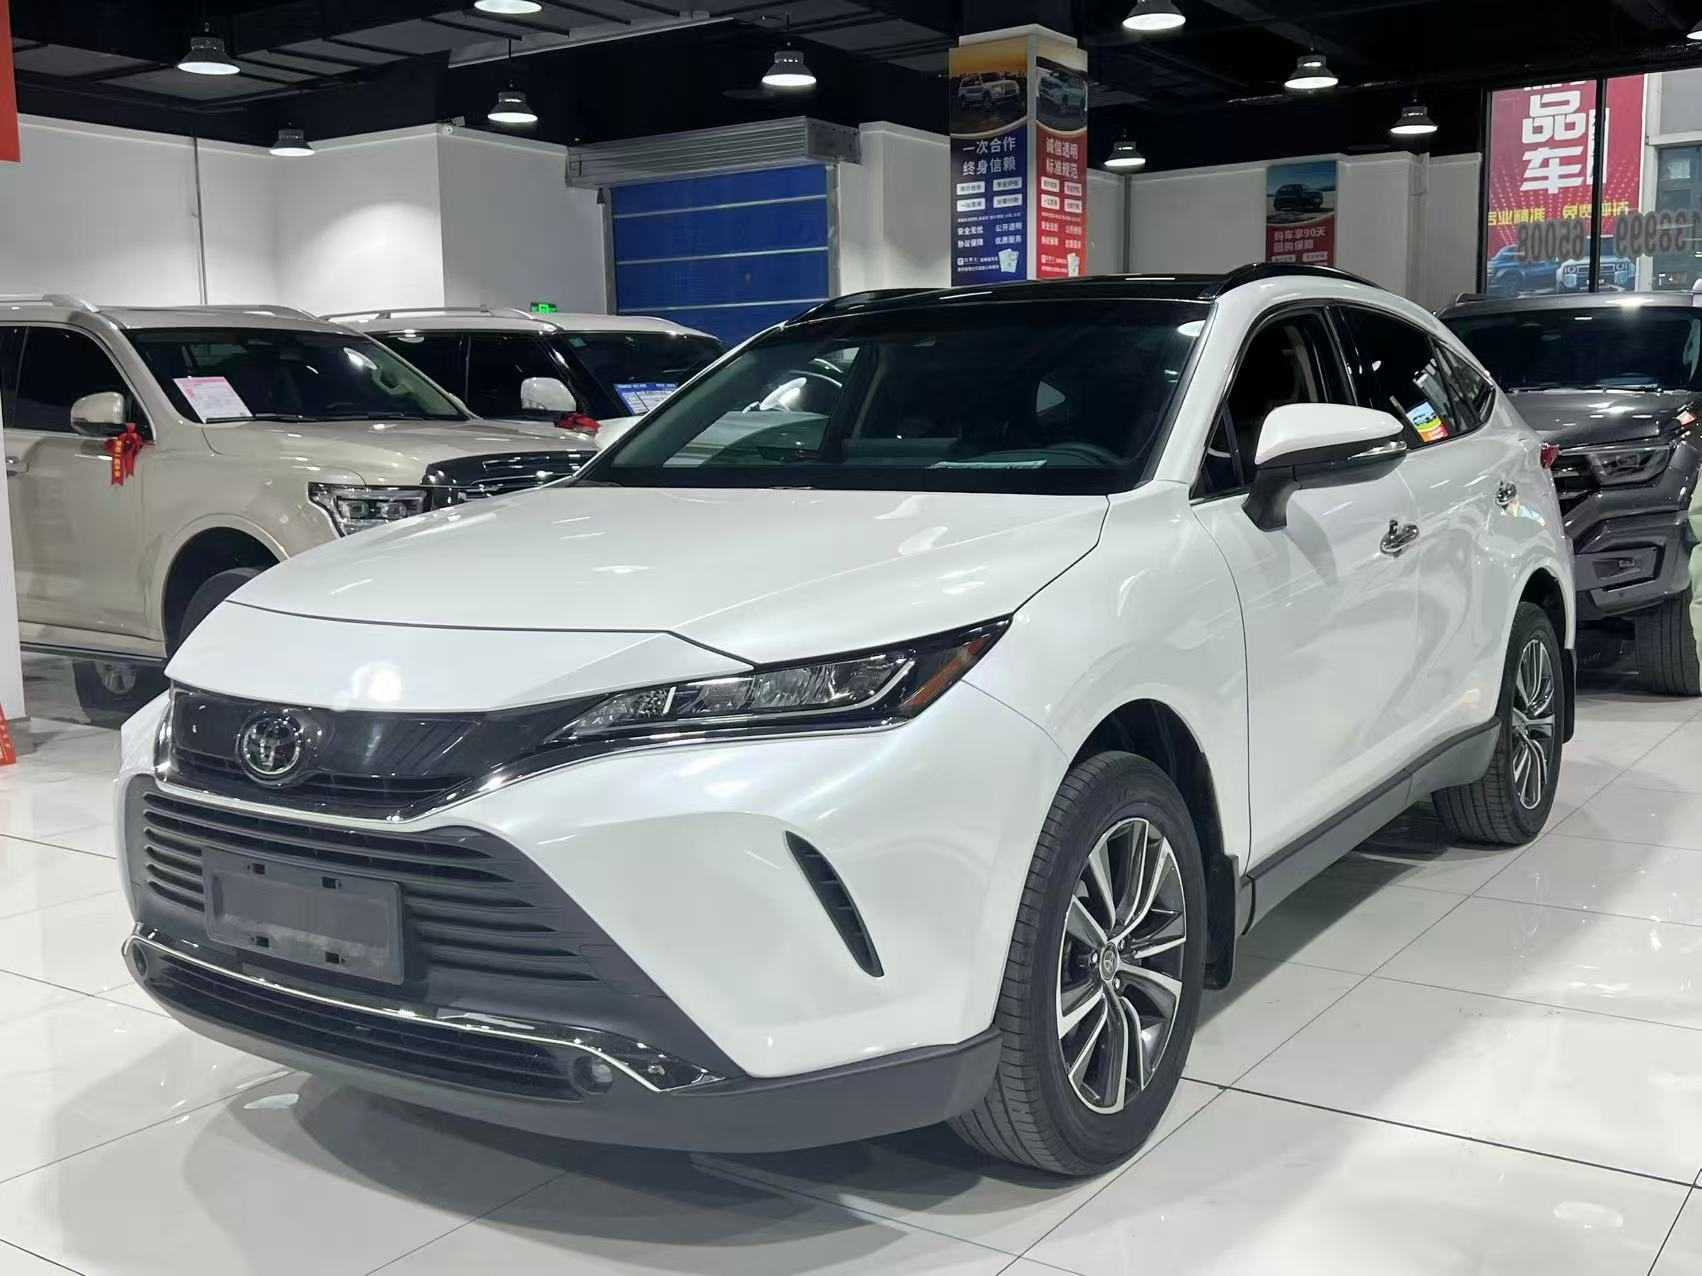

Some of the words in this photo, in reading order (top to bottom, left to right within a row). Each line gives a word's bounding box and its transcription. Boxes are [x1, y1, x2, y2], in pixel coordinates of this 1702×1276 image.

[962, 136, 1016, 154] 一次合作
[1520, 81, 1586, 194] 品车
[962, 156, 1016, 176] 终身信赖
